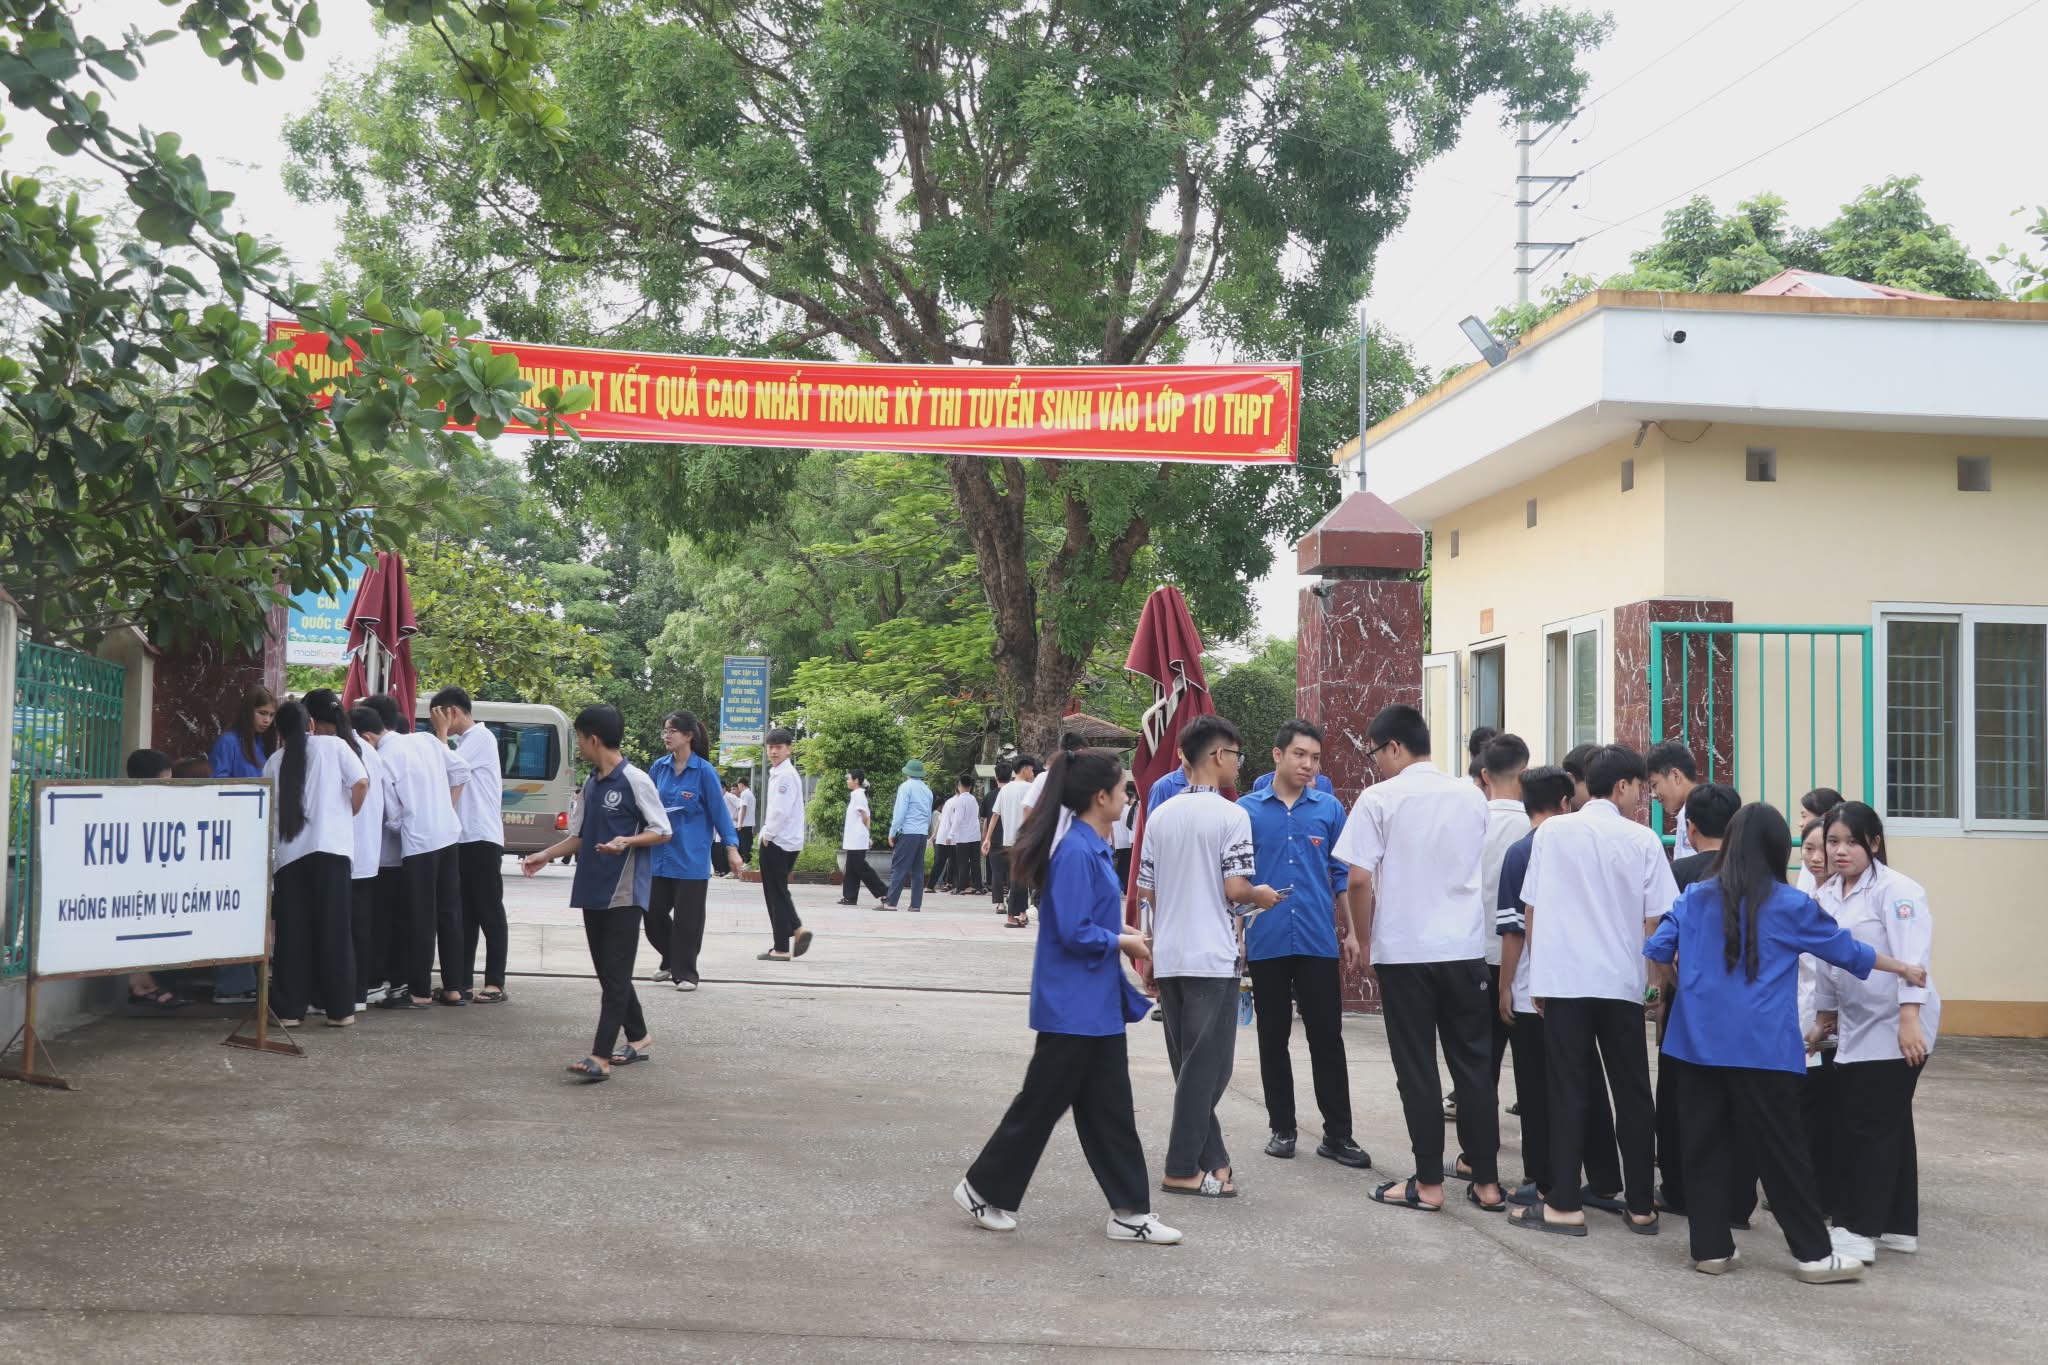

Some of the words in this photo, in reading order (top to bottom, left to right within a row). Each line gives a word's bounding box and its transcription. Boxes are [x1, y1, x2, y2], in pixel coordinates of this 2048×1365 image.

[610, 363, 651, 414] KẾT
[656, 366, 700, 420] QUẢ
[705, 378, 749, 419] CAO
[755, 370, 813, 421] NHẤT
[818, 383, 889, 425] TRONG
[894, 380, 923, 426] KỲ
[929, 387, 963, 427] THI
[968, 375, 1037, 430] TUYỂN
[1040, 389, 1093, 430] SINH
[1098, 383, 1140, 432] VÀO
[1145, 383, 1186, 434] LỚP
[1191, 396, 1217, 435] 10
[1222, 393, 1274, 436] THPT
[301, 612, 332, 630] QUỐC
[84, 822, 130, 866] KHU
[142, 820, 187, 868] VỰC
[197, 819, 232, 861] THI
[58, 893, 107, 922] KHÔNG
[111, 890, 157, 920] NHIỆM
[161, 892, 178, 919] VỤ
[181, 882, 212, 914] CẤM
[216, 885, 241, 912] VÀO
